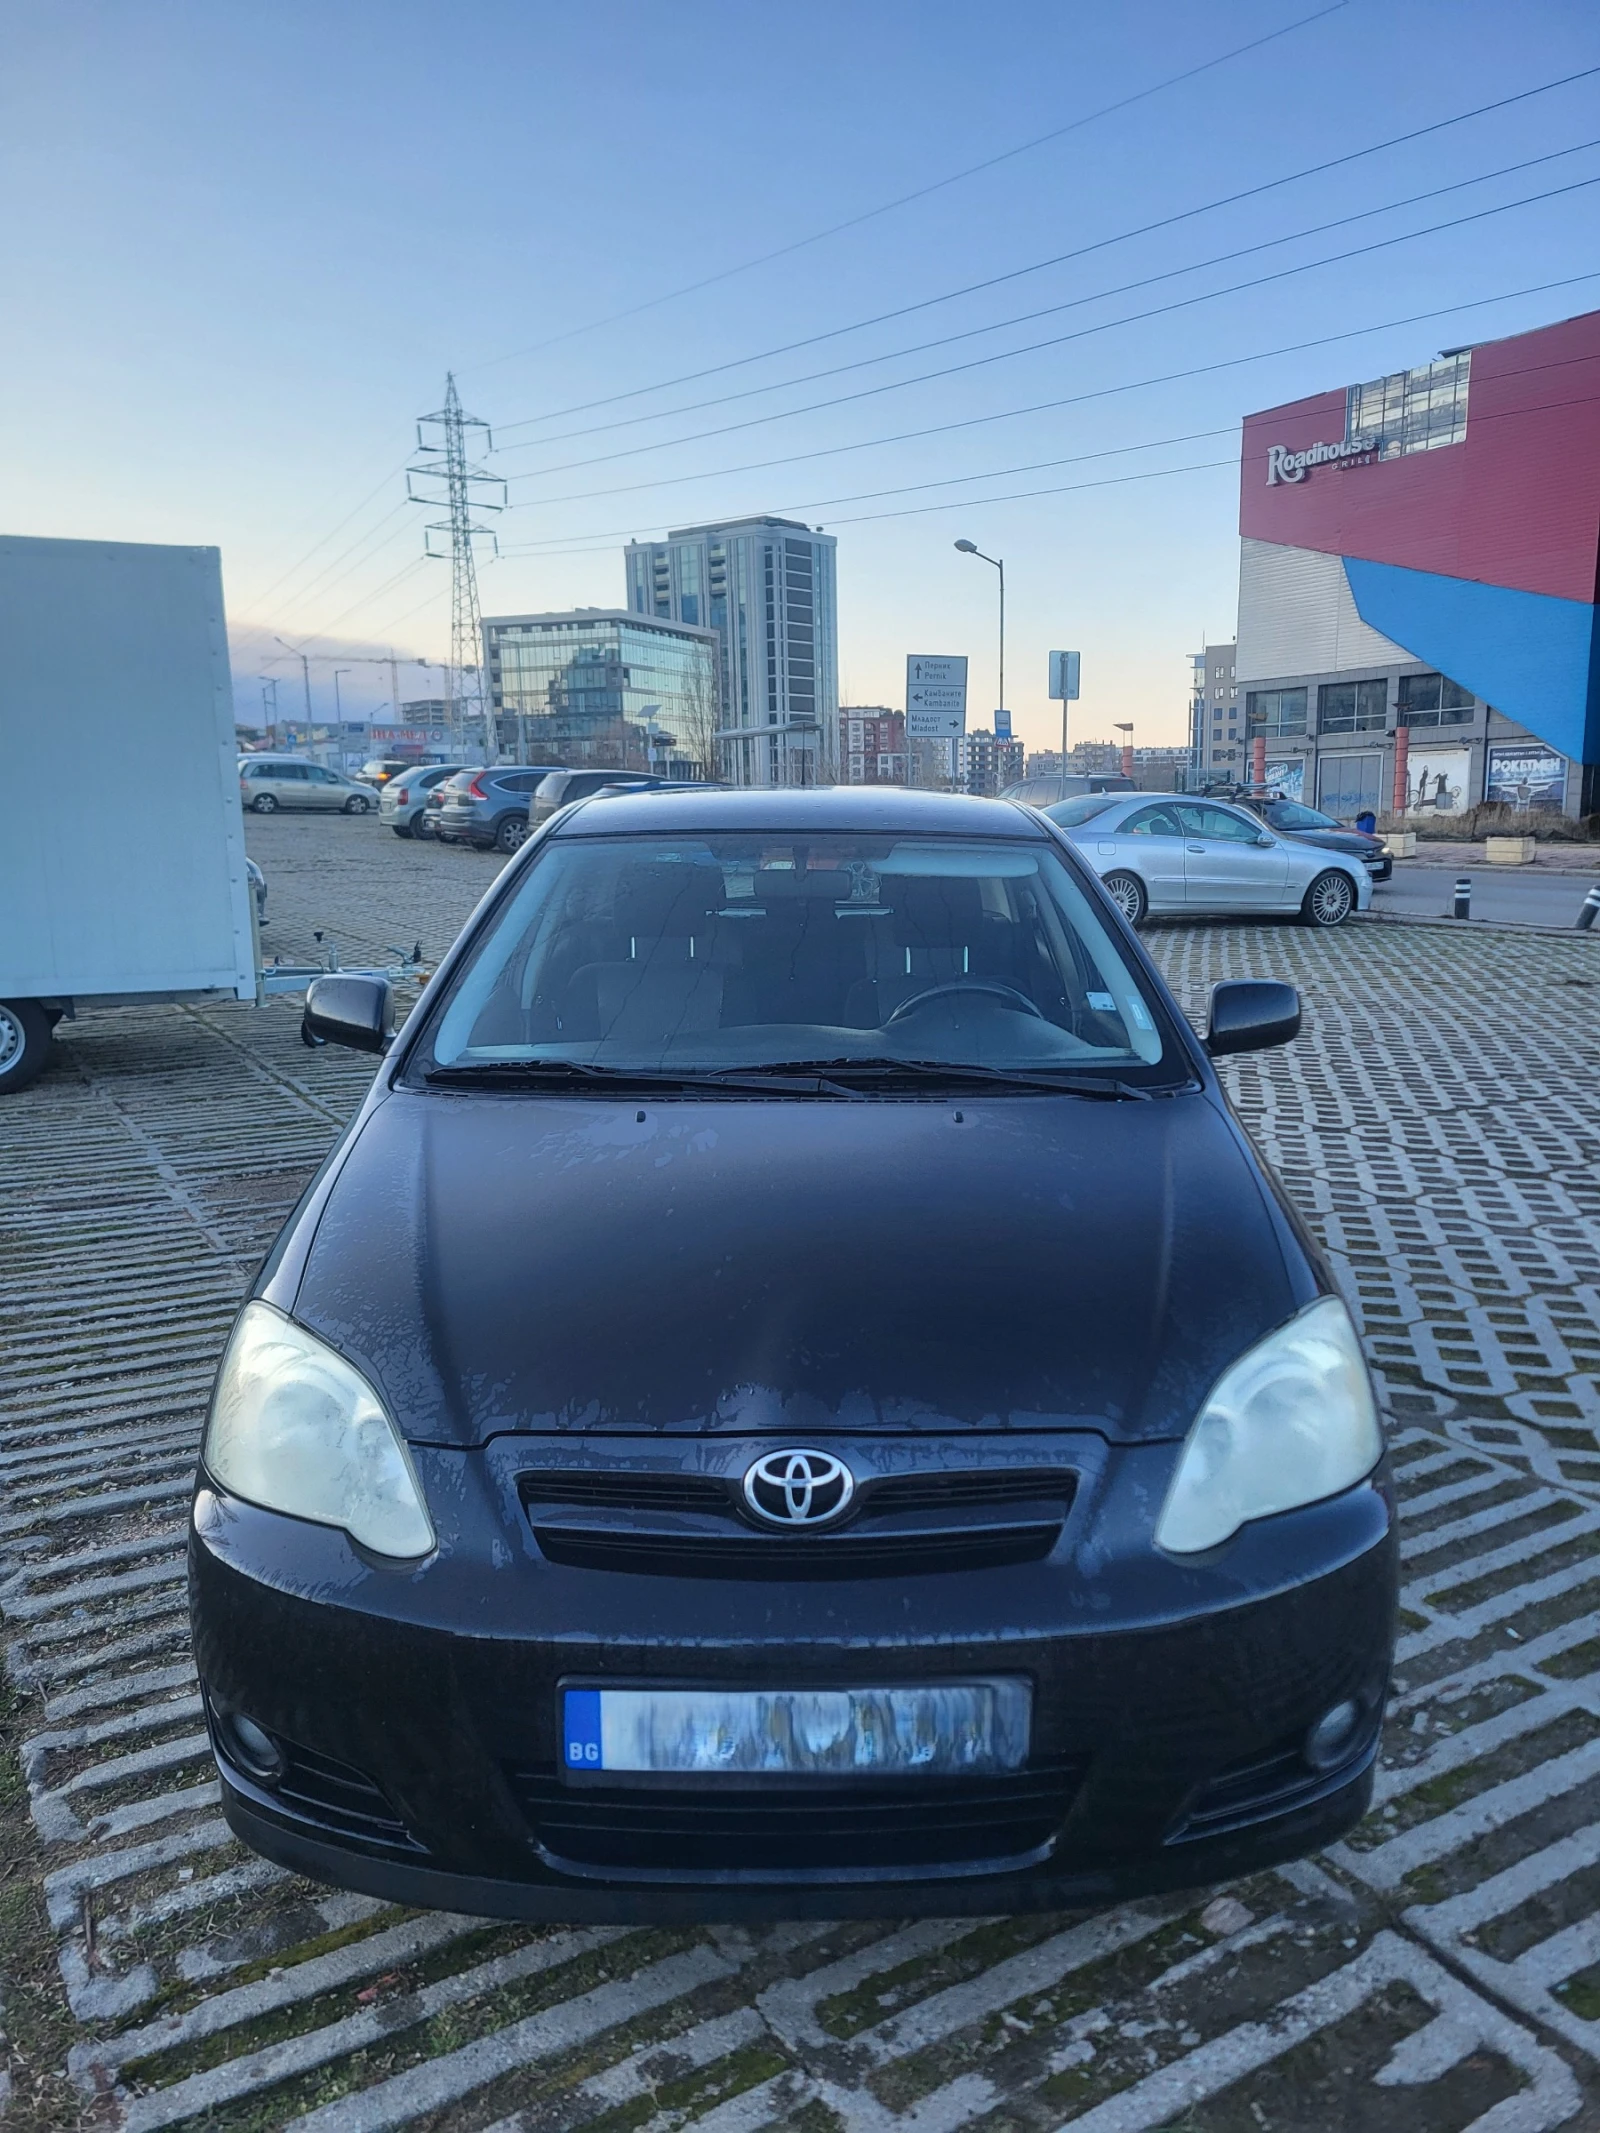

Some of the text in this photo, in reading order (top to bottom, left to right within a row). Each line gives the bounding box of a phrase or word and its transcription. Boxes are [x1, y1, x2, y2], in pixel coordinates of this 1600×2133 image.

[1266, 437, 1376, 486] Roadhouse
[925, 661, 951, 671] Перник
[925, 672, 947, 680] Pernik
[925, 689, 962, 697] Камбаните
[924, 699, 960, 707] Kambanite
[911, 715, 941, 723] Младост
[911, 724, 939, 732] Mladost
[1491, 758, 1560, 773] РОКЕТМЕН
[569, 1743, 598, 1761] BG
